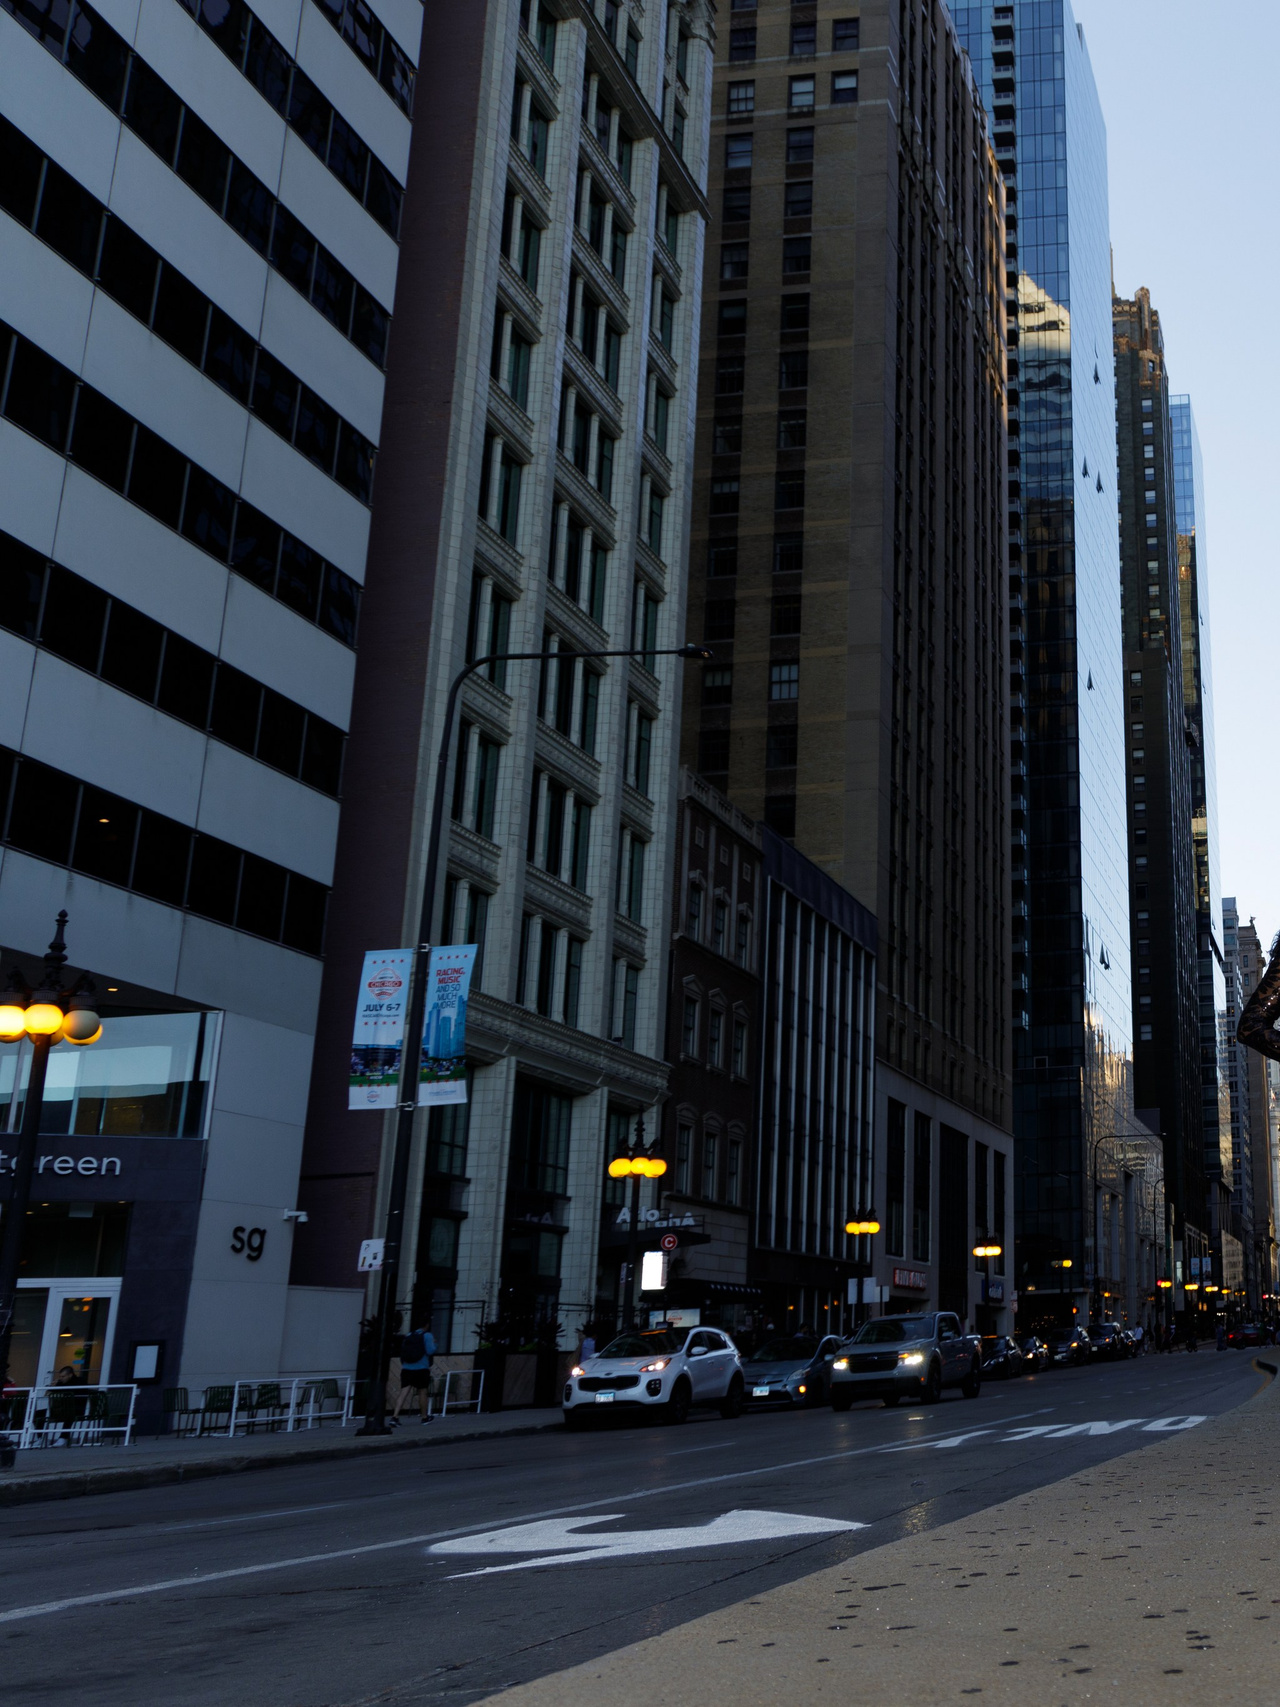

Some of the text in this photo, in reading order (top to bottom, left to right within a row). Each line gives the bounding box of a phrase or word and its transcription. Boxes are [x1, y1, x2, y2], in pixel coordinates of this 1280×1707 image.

[436, 966, 466, 977] RACING,
[437, 975, 461, 985] MUSIC
[435, 983, 461, 993] AND SO
[437, 992, 457, 1001] MUCH
[363, 1003, 401, 1012] JULY 6-7
[436, 1000, 456, 1009] MORE
[615, 1206, 660, 1225] Alo
[231, 1226, 267, 1261] sg
[664, 1237, 674, 1248] C
[876, 1415, 1208, 1453] ONLY
